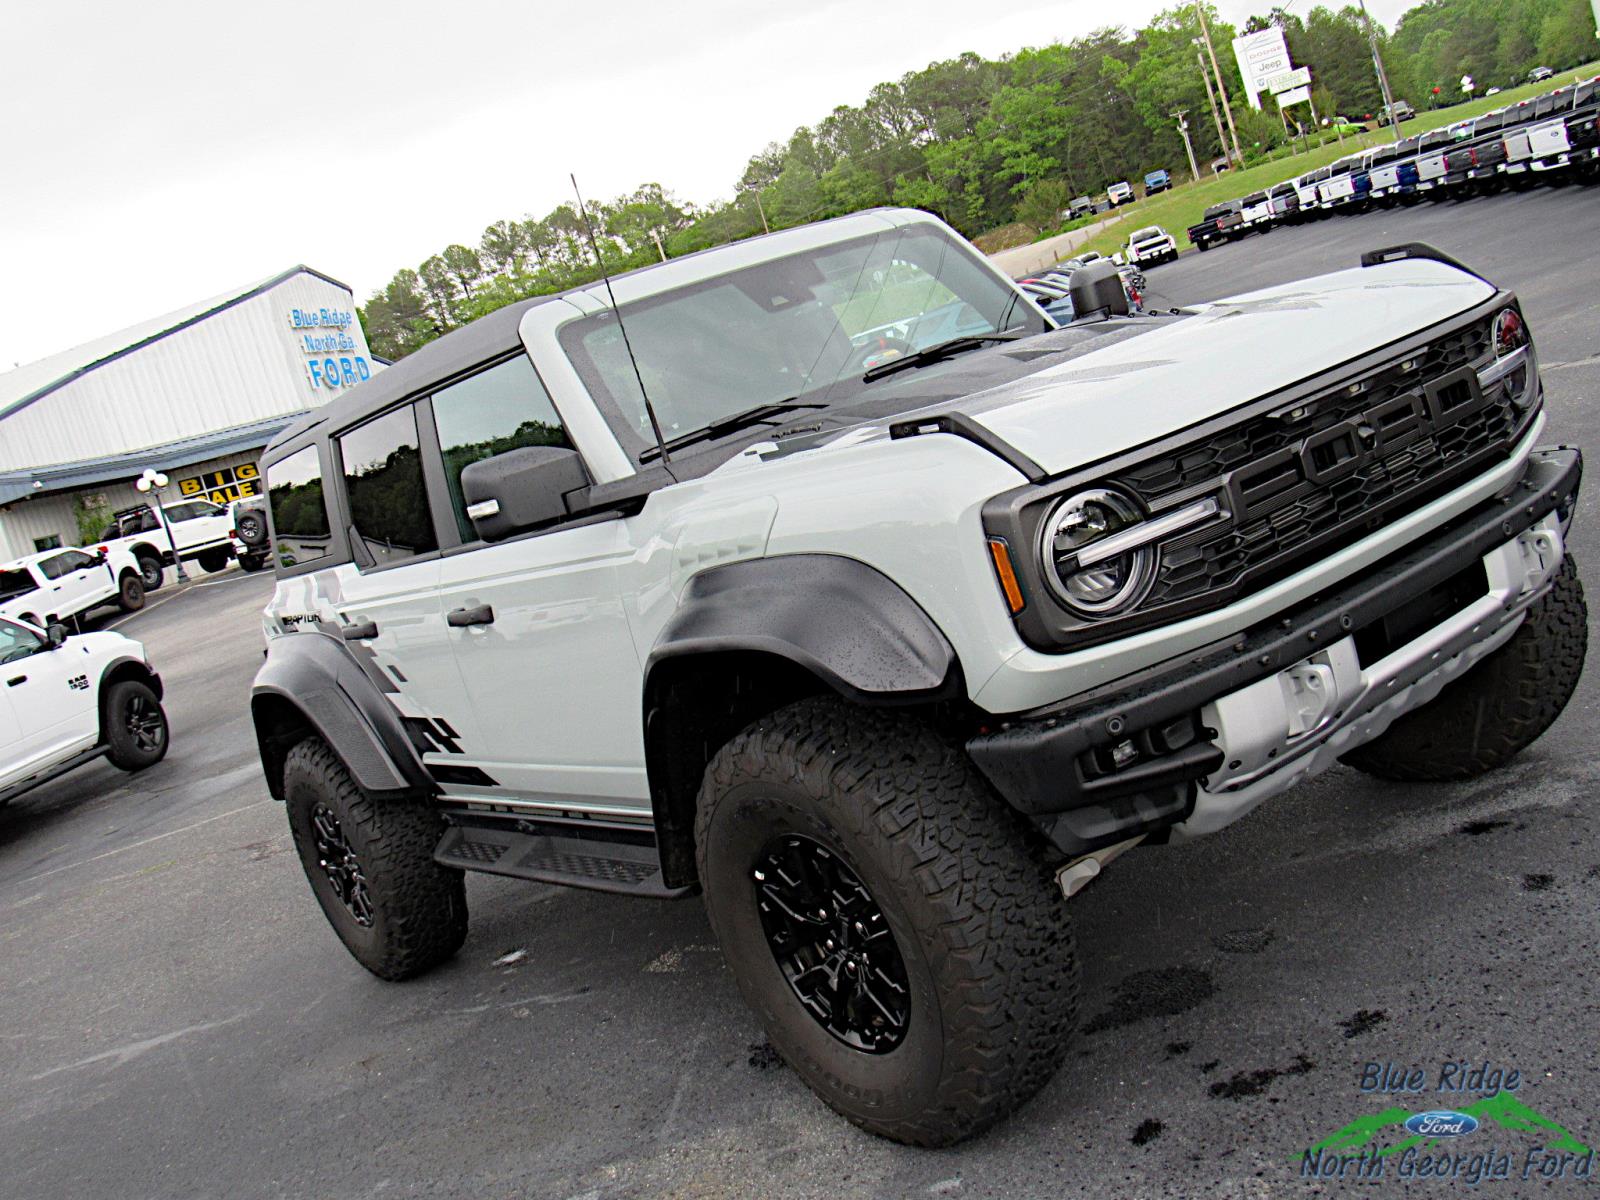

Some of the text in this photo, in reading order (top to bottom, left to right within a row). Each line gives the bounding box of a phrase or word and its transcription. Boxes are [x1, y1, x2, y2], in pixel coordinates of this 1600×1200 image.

[1259, 60, 1282, 71] Jeep
[292, 308, 352, 328] Blue Ridge
[304, 335, 337, 351] North
[308, 356, 369, 387] FORD
[1226, 365, 1487, 525] FORD
[179, 464, 257, 495] BIG
[68, 674, 87, 684] RAM
[70, 679, 89, 689] 1500
